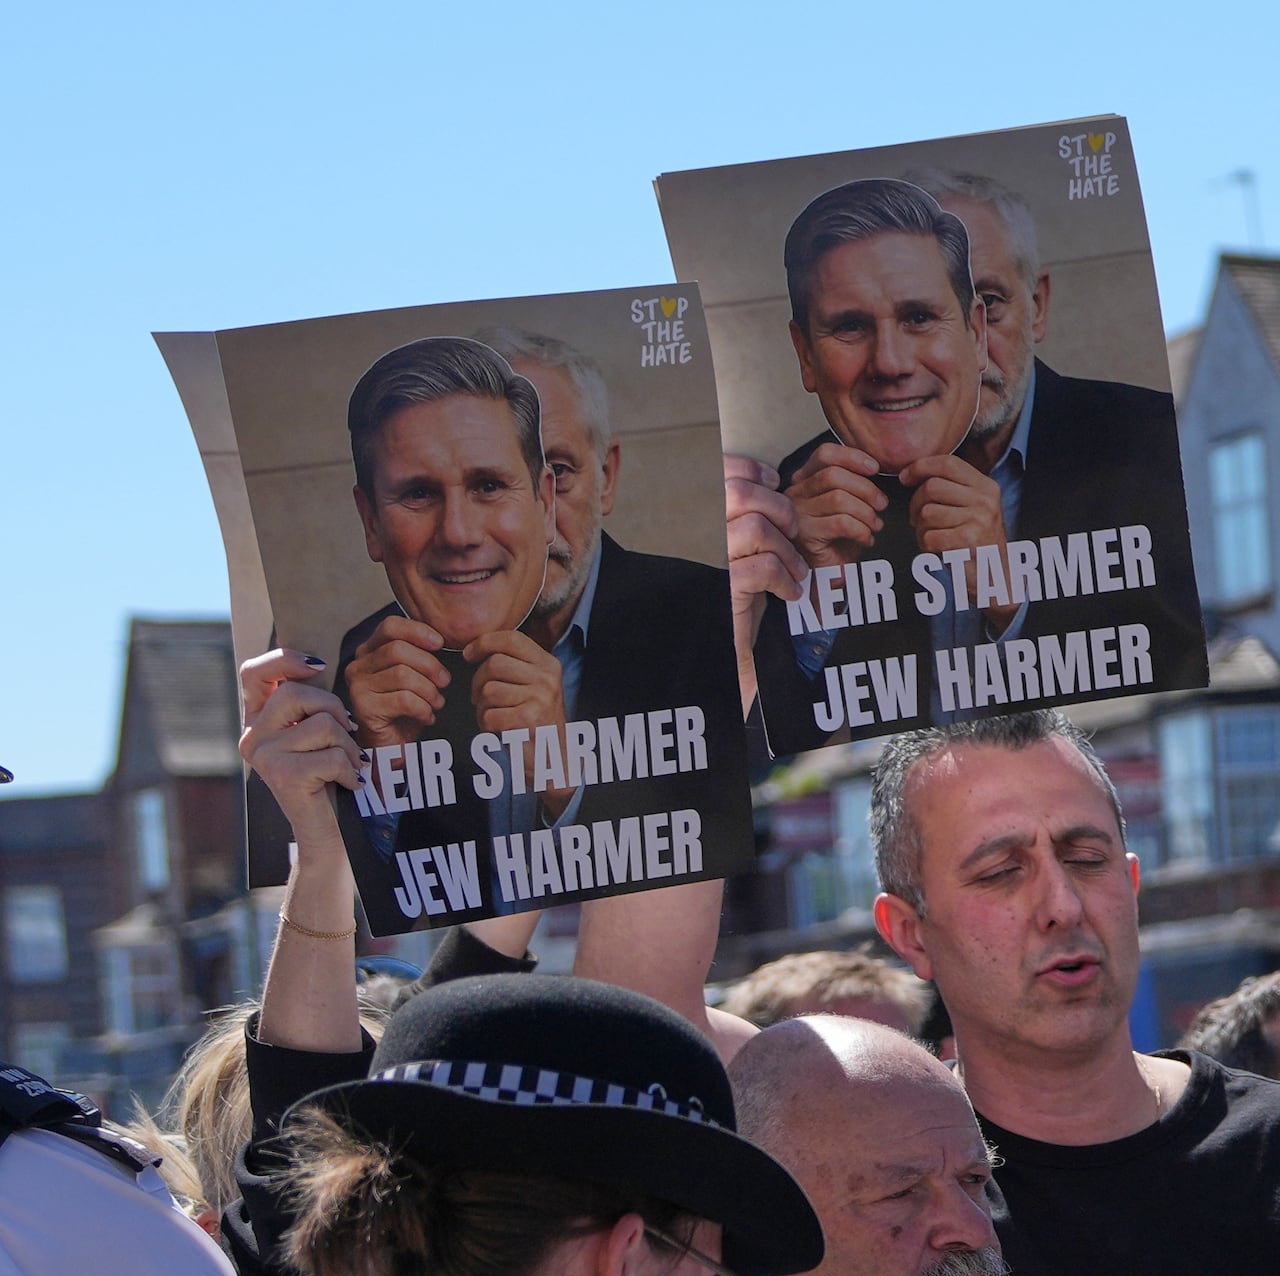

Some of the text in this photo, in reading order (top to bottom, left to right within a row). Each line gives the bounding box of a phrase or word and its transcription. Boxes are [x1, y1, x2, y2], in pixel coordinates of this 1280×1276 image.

[1068, 174, 1119, 200] HATE
[1069, 153, 1112, 175] THE
[640, 340, 693, 368] HATE
[641, 319, 686, 343] THE
[787, 524, 1156, 636] KEIR STARMER
[812, 623, 1153, 732] JEW HARMER
[353, 706, 708, 818] KEIR STARMER
[394, 809, 703, 919] JEW HARMER
